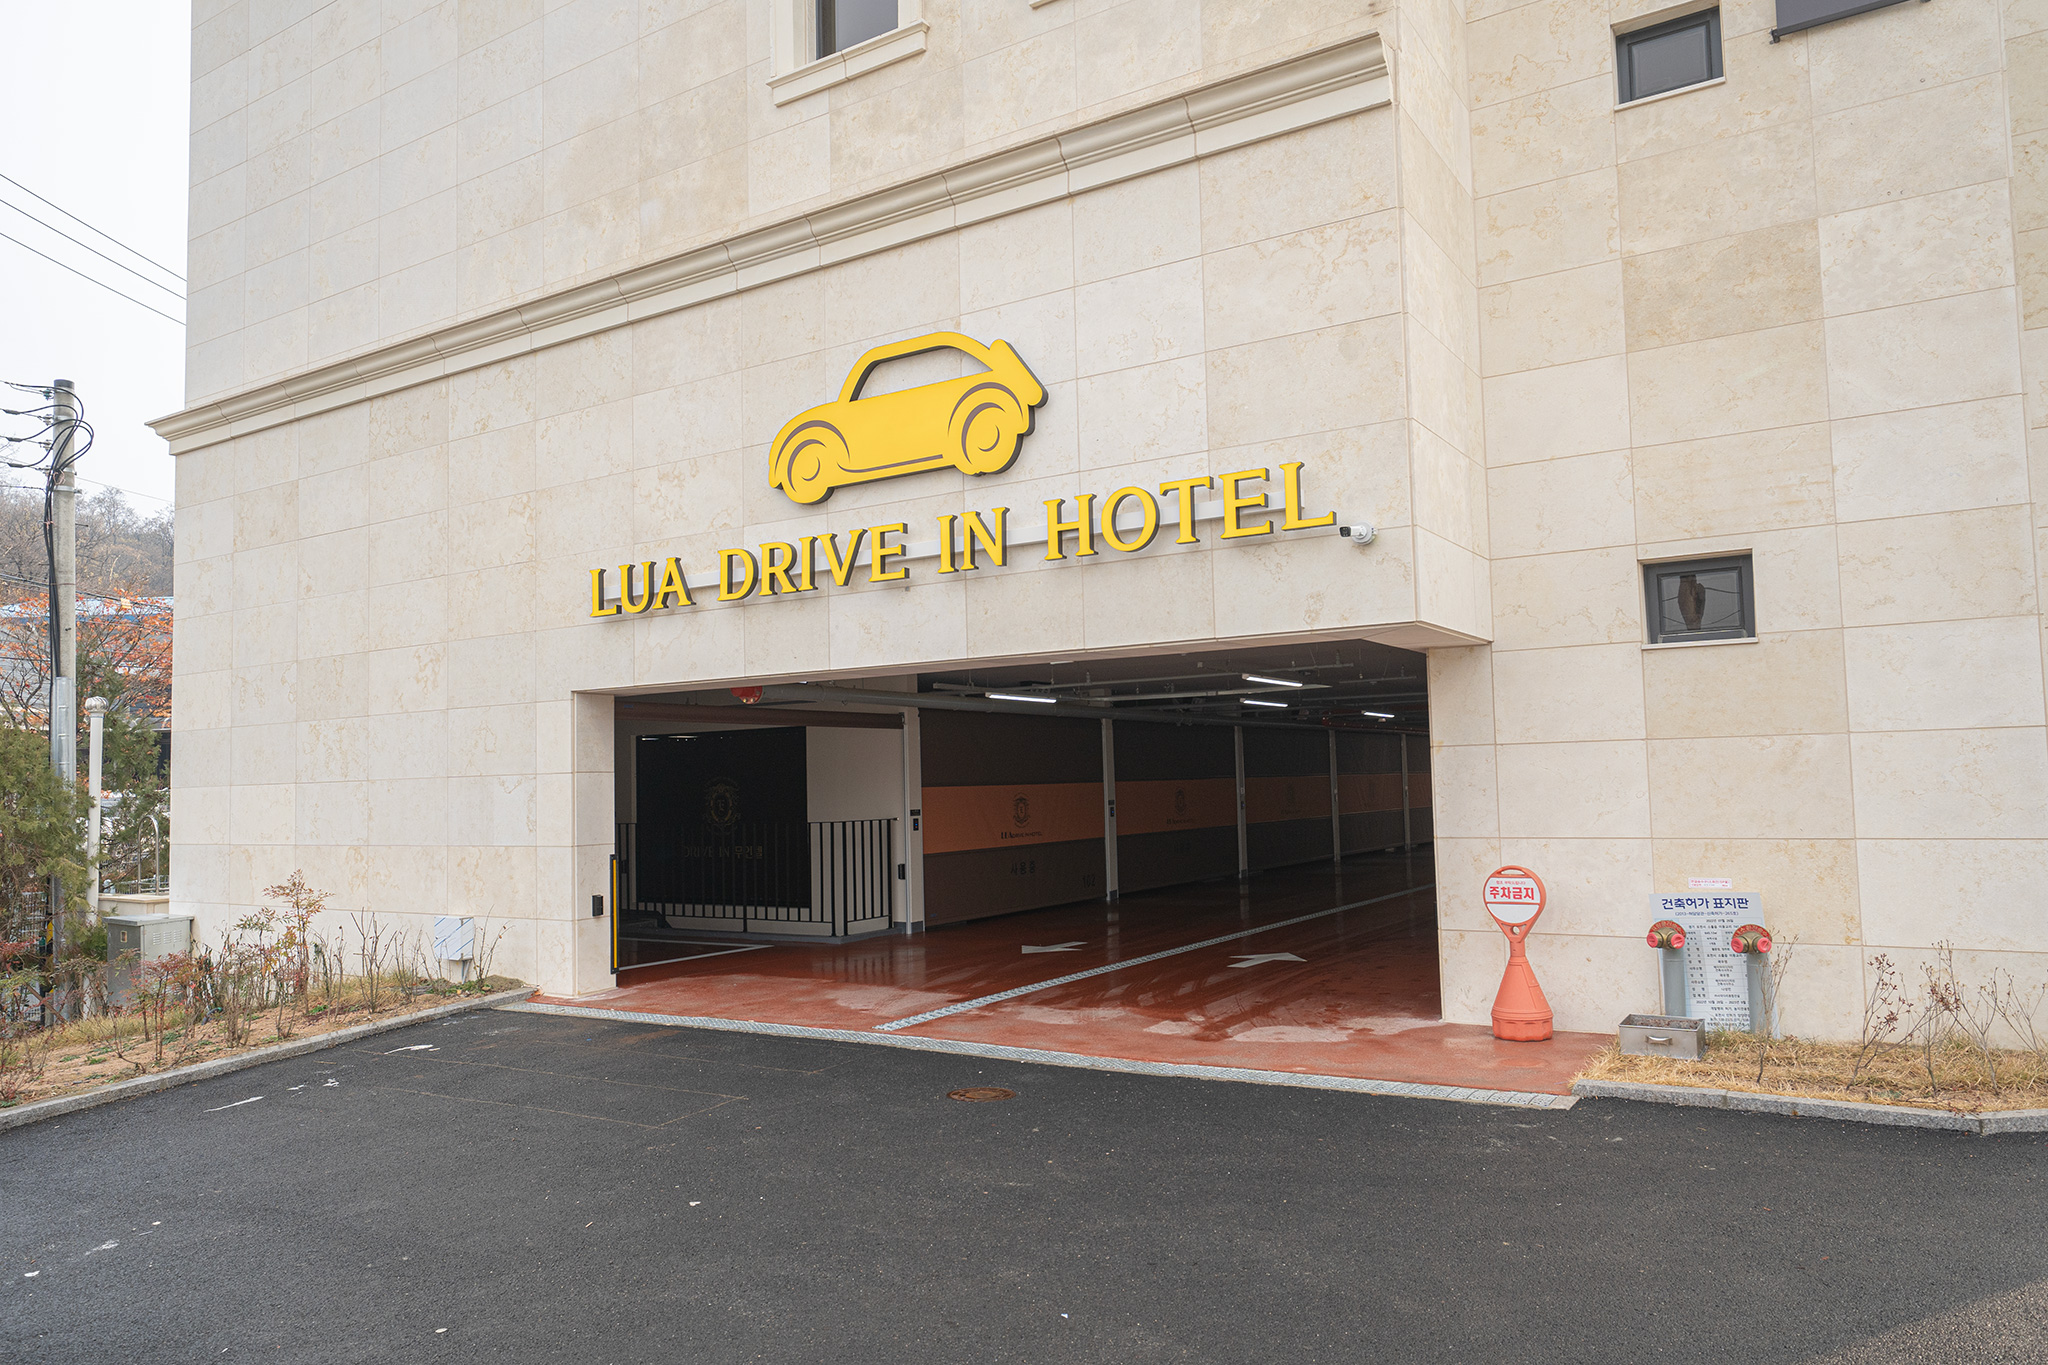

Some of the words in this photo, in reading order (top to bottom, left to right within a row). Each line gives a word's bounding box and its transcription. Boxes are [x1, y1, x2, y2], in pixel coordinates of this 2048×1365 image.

[590, 557, 696, 618] LUA
[717, 522, 909, 602] DRIVE
[937, 506, 1009, 574] IN
[1043, 461, 1337, 561] HOTEL
[1489, 886, 1535, 901] 주차금지
[1661, 897, 1710, 910] 건축허가
[1712, 897, 1749, 910] 표지판
